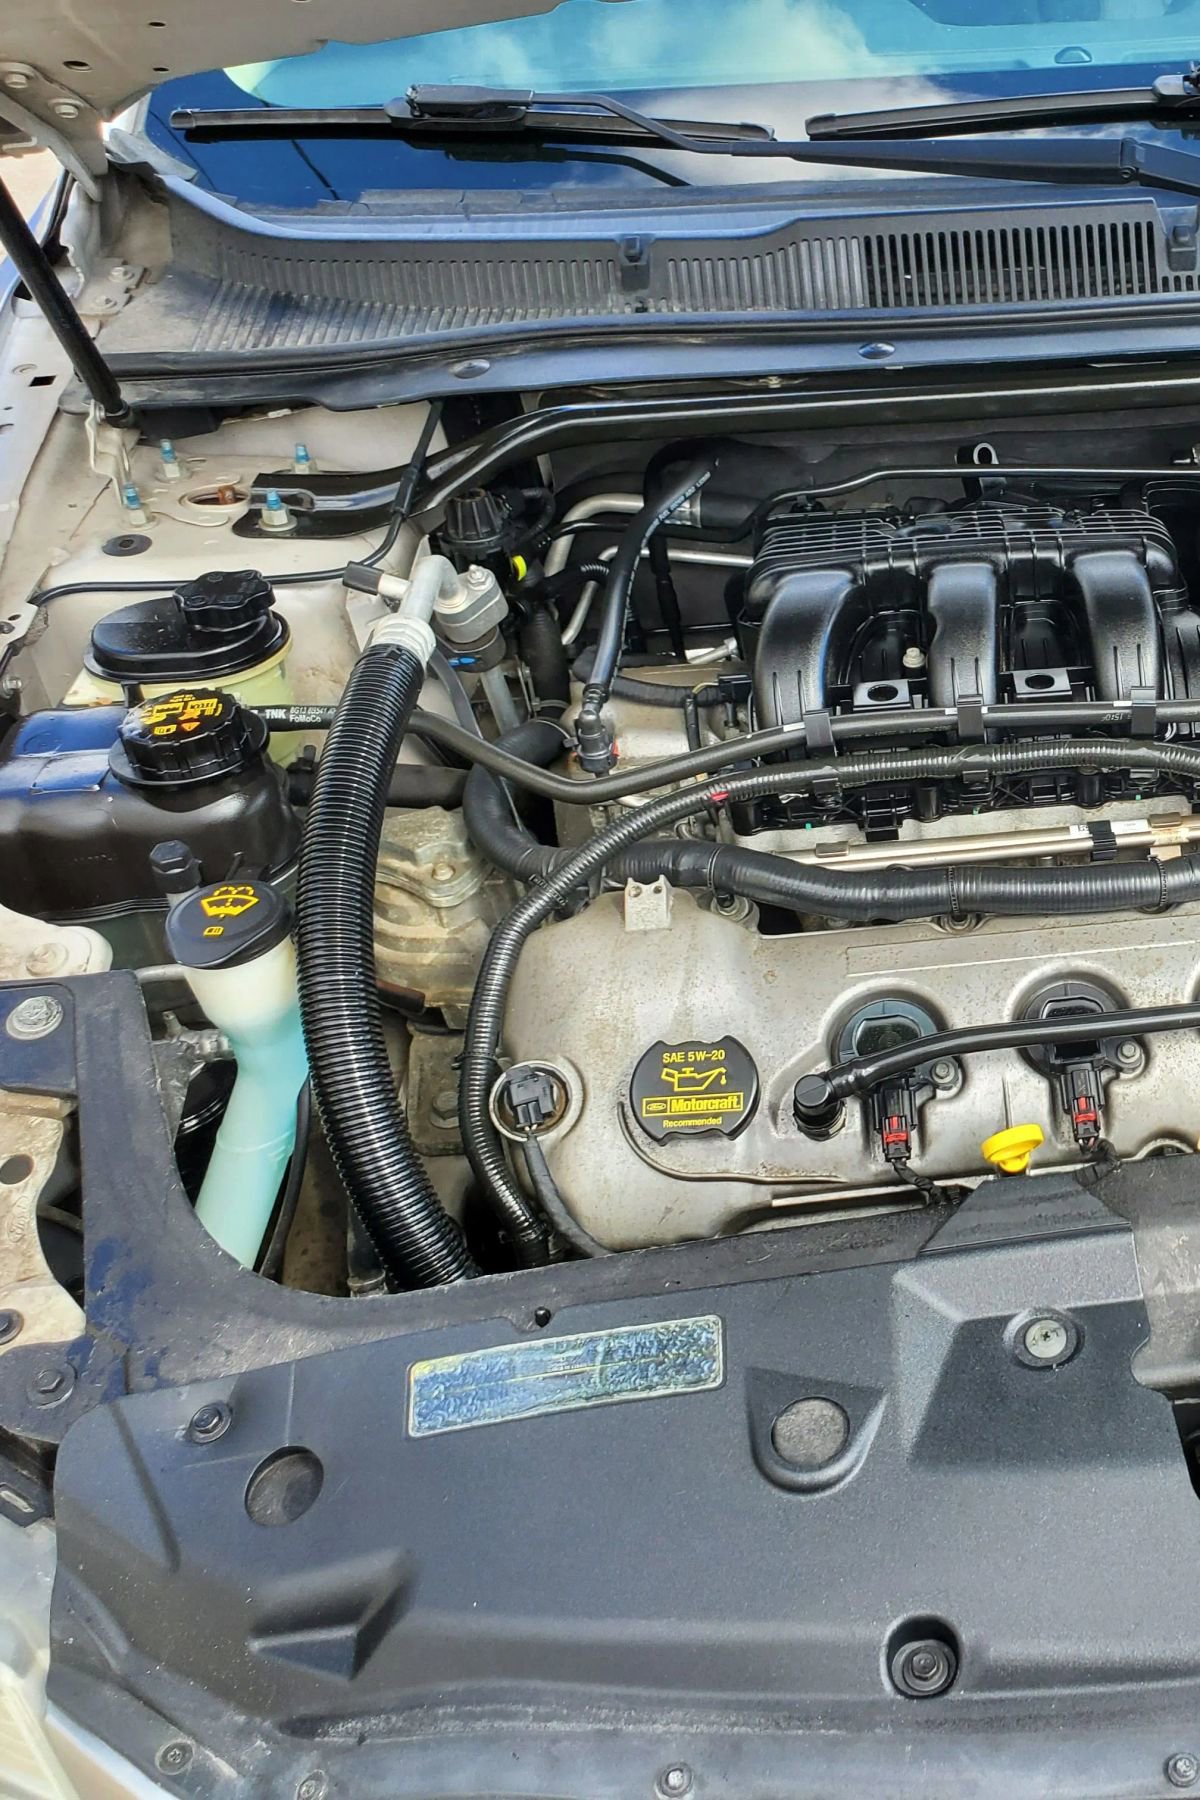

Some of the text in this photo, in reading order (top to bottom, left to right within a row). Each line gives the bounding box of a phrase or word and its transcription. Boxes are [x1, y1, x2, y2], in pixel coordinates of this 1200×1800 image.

[264, 708, 287, 719] TNK
[289, 714, 322, 723] FoMoCo
[662, 1049, 726, 1064] SAE 5W-20
[662, 1116, 722, 1128] Recommended
